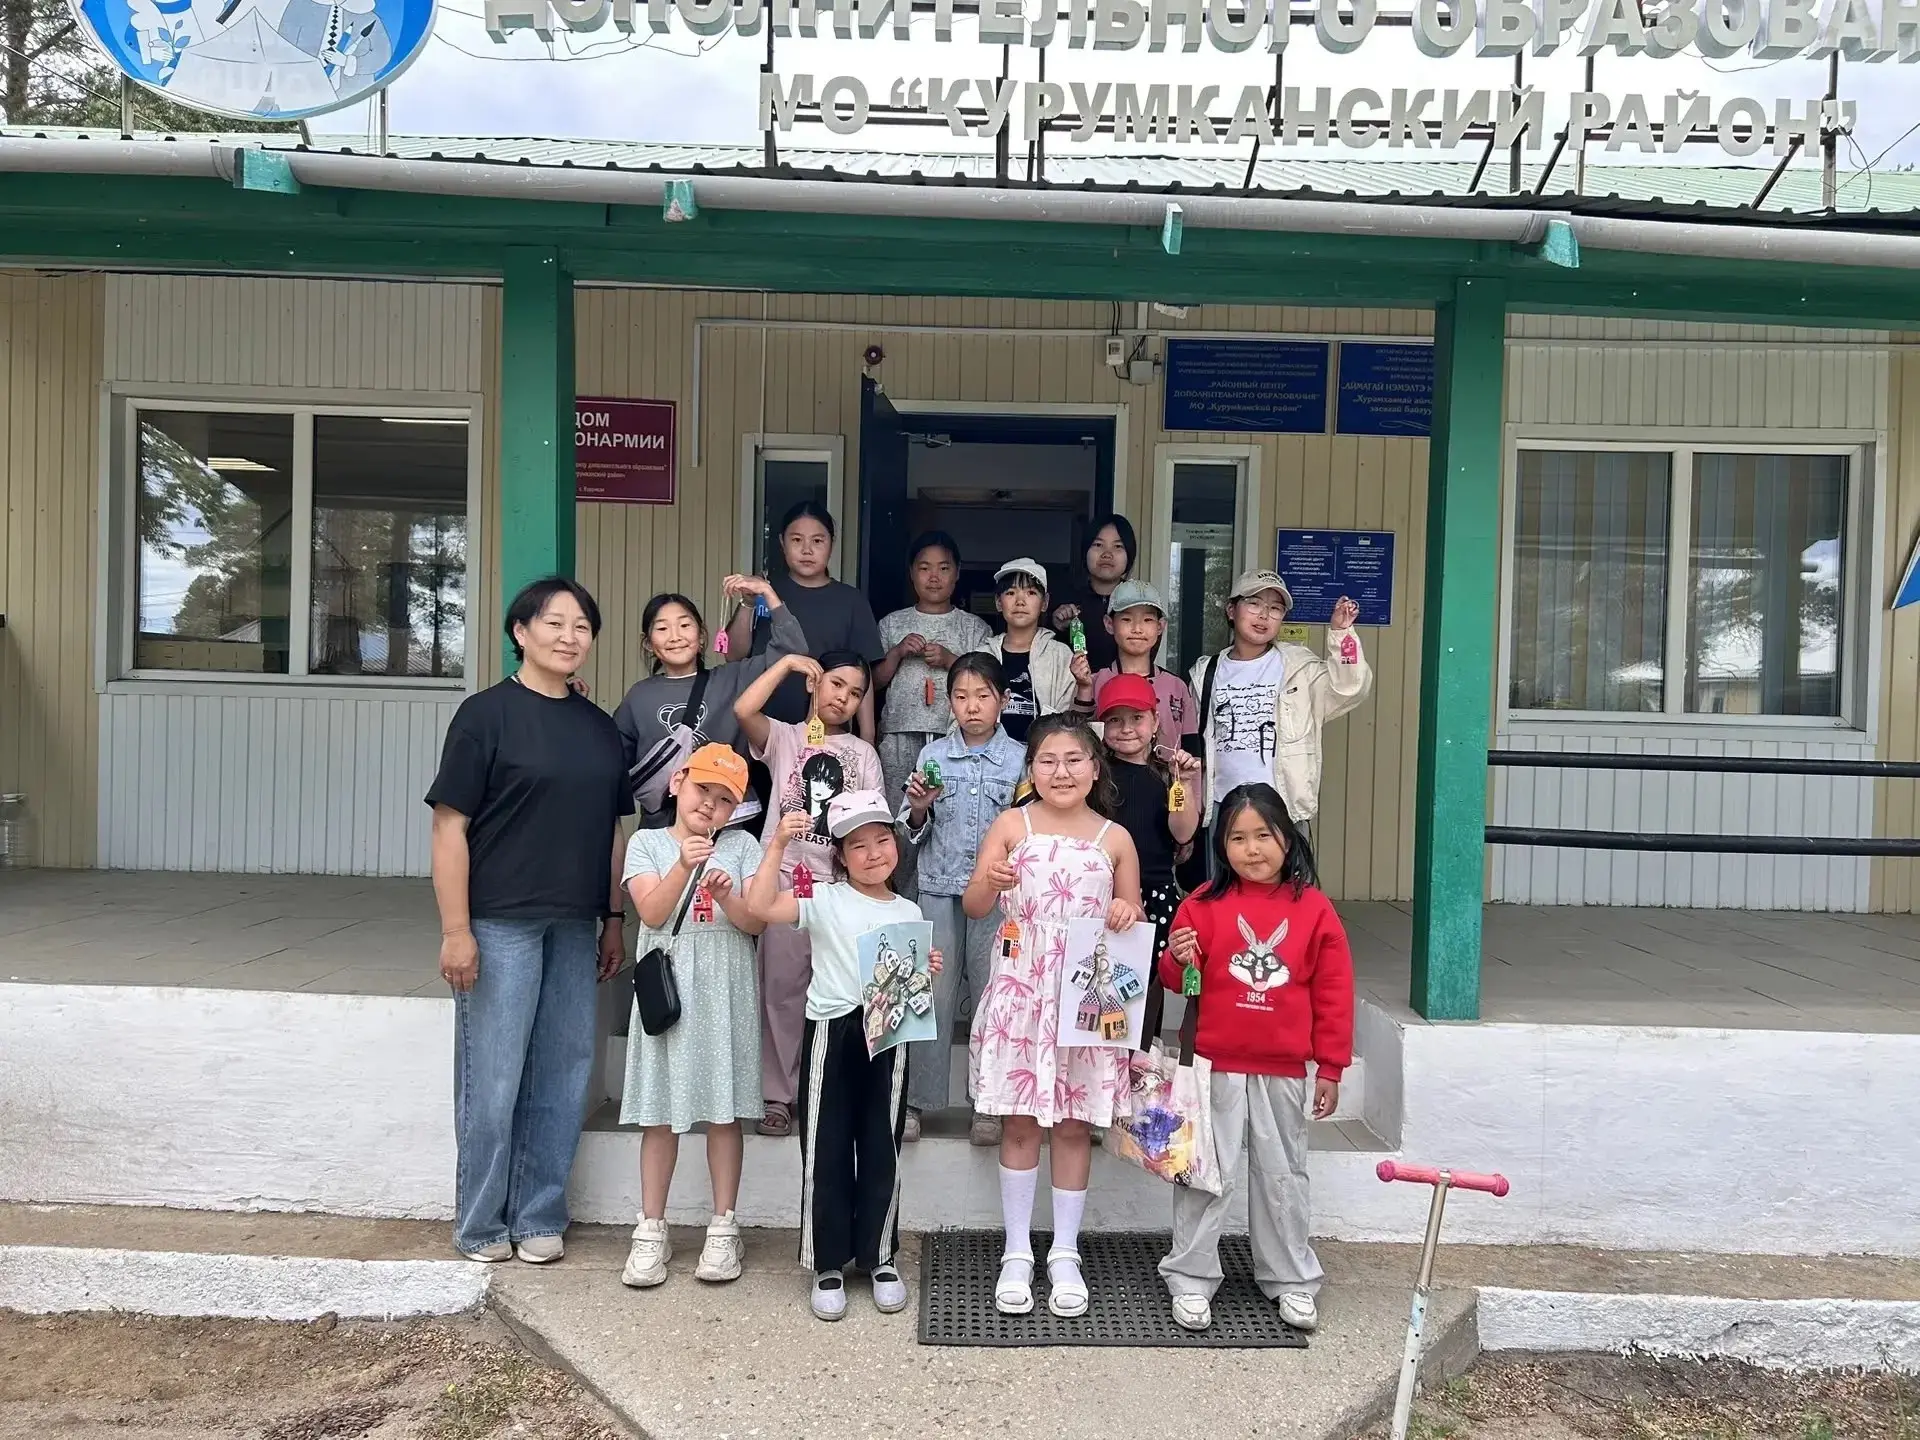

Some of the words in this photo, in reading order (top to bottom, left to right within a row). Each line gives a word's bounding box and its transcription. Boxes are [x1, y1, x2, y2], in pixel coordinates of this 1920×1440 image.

[759, 73, 869, 135] МО
[805, 834, 832, 846] EASY
[1246, 991, 1266, 1003] 1954
